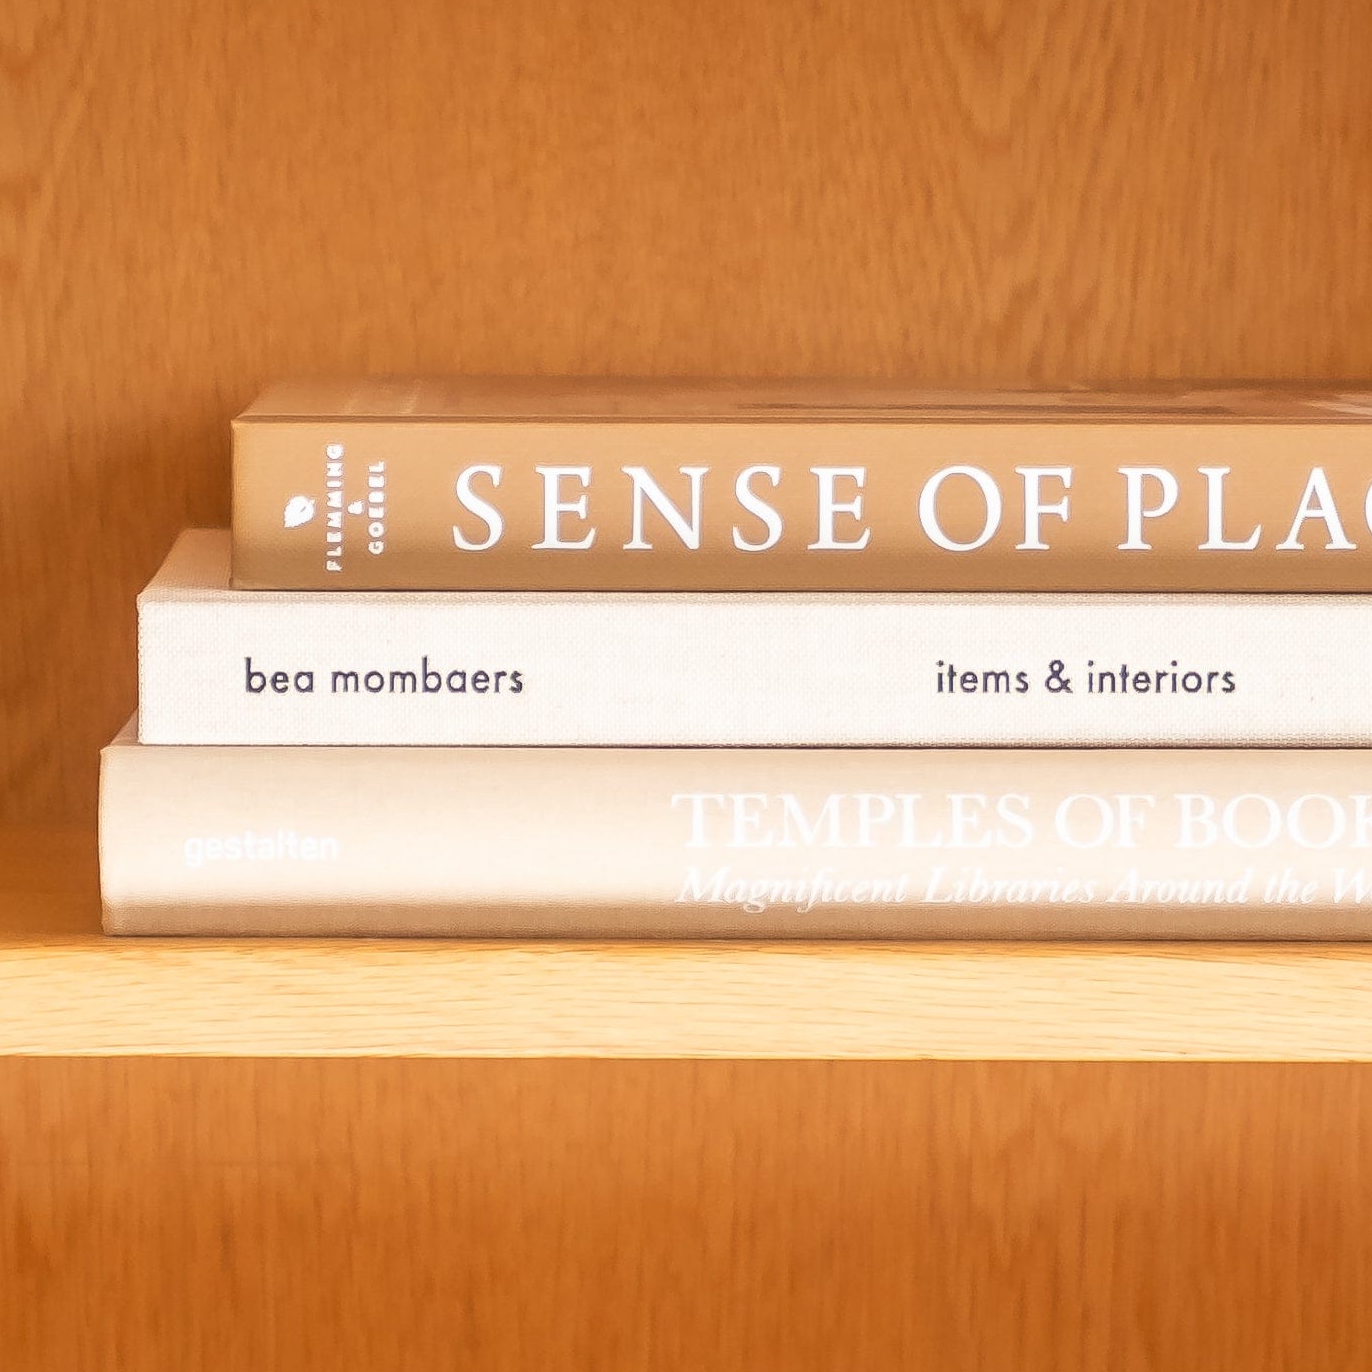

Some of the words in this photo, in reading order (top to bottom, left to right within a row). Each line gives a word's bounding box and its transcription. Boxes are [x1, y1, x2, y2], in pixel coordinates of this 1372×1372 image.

[451, 464, 871, 552] SENSE
[918, 464, 1073, 552] OF
[244, 656, 314, 694] bea
[330, 656, 524, 694] mombaers
[936, 660, 1029, 694] items
[1045, 660, 1073, 694] &
[1088, 660, 1236, 694] interiors
[671, 792, 1031, 849] TEMPLES
[1053, 792, 1155, 849] OF
[184, 832, 339, 867] gestalten
[675, 867, 908, 913] Magnificent
[921, 867, 1096, 905] Libraries
[1107, 867, 1249, 904] Around
[1262, 868, 1318, 904] the
